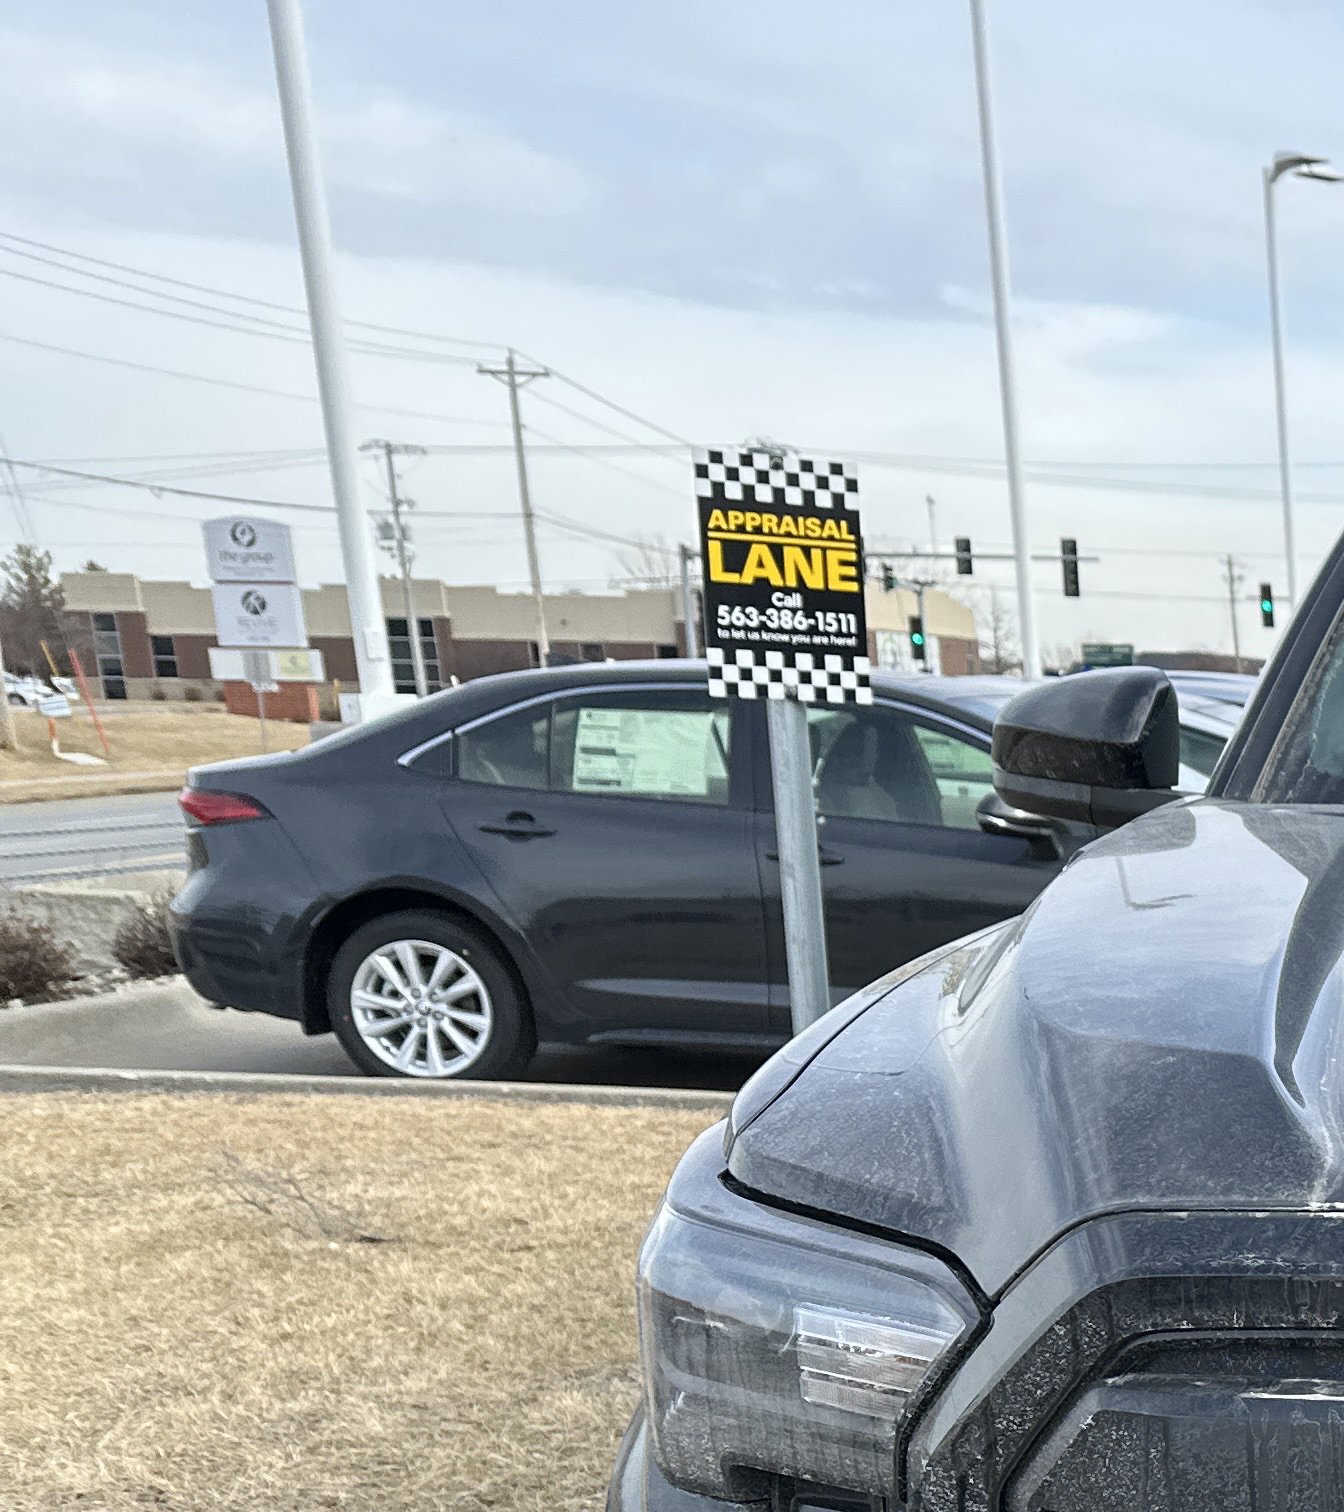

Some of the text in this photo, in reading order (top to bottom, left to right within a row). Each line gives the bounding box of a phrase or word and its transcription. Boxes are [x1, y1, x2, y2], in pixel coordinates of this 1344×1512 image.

[707, 508, 856, 541] APPRAISAL
[707, 540, 860, 593] LANE
[771, 591, 803, 609] Call
[717, 604, 858, 634] 563-386-1511
[717, 627, 731, 640] to
[731, 628, 746, 640] let
[747, 630, 760, 641] us
[761, 630, 790, 642] know
[790, 633, 811, 646] you
[812, 634, 829, 644] are
